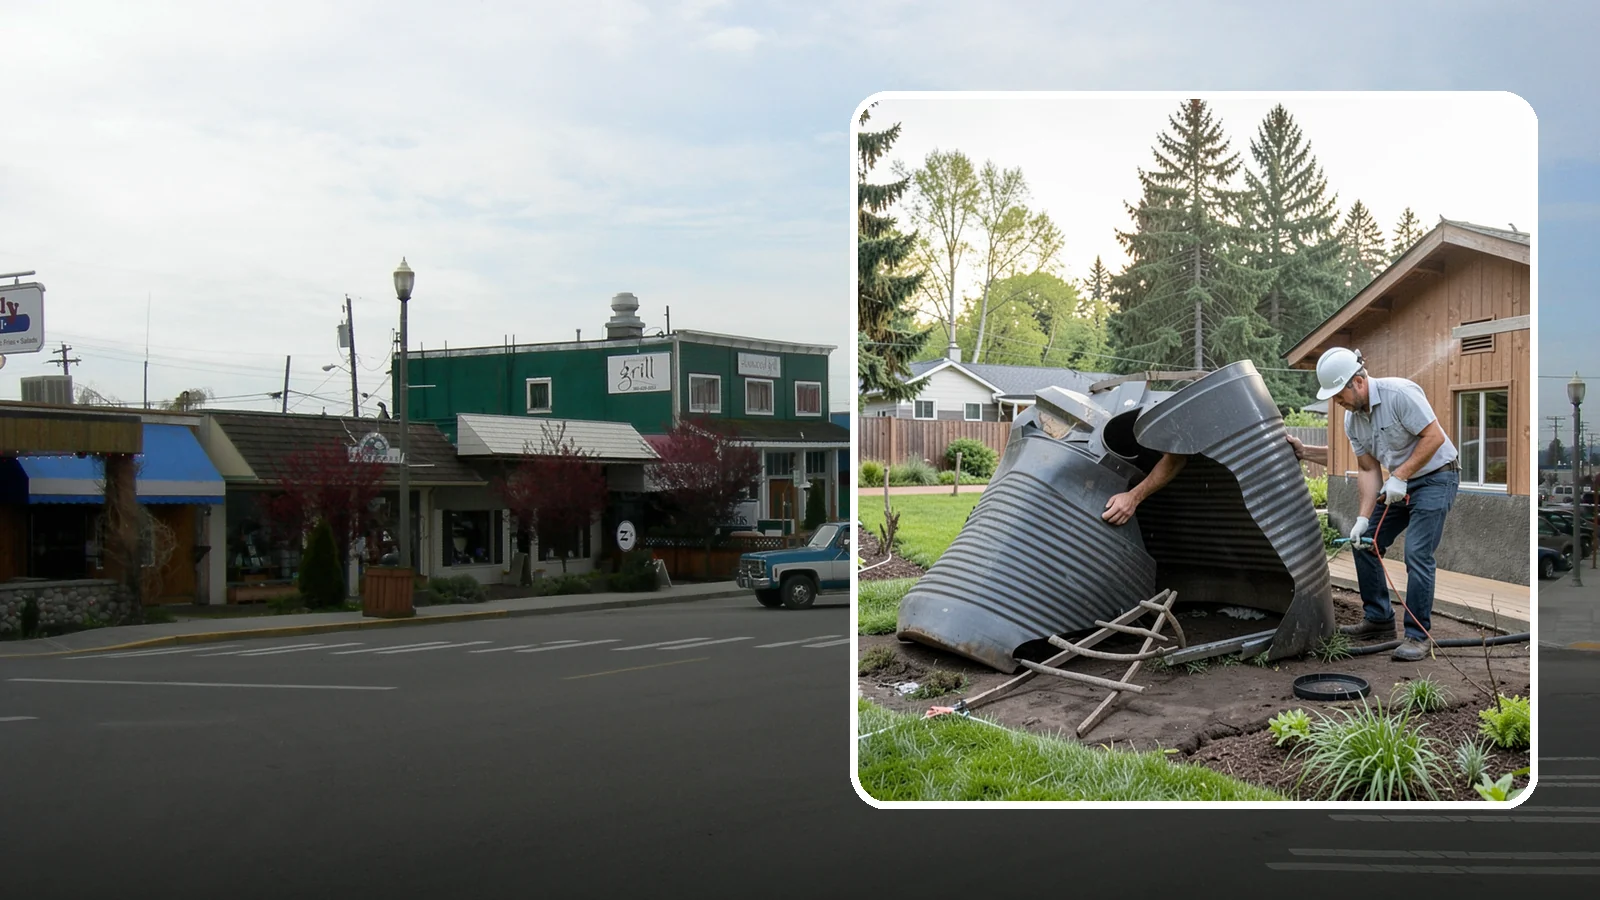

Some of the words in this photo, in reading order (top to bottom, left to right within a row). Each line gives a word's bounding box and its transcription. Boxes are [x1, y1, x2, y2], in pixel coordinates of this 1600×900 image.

[0, 297, 19, 324] ly
[3, 338, 16, 346] Fries
[20, 337, 38, 345] Salads
[618, 355, 655, 391] grill
